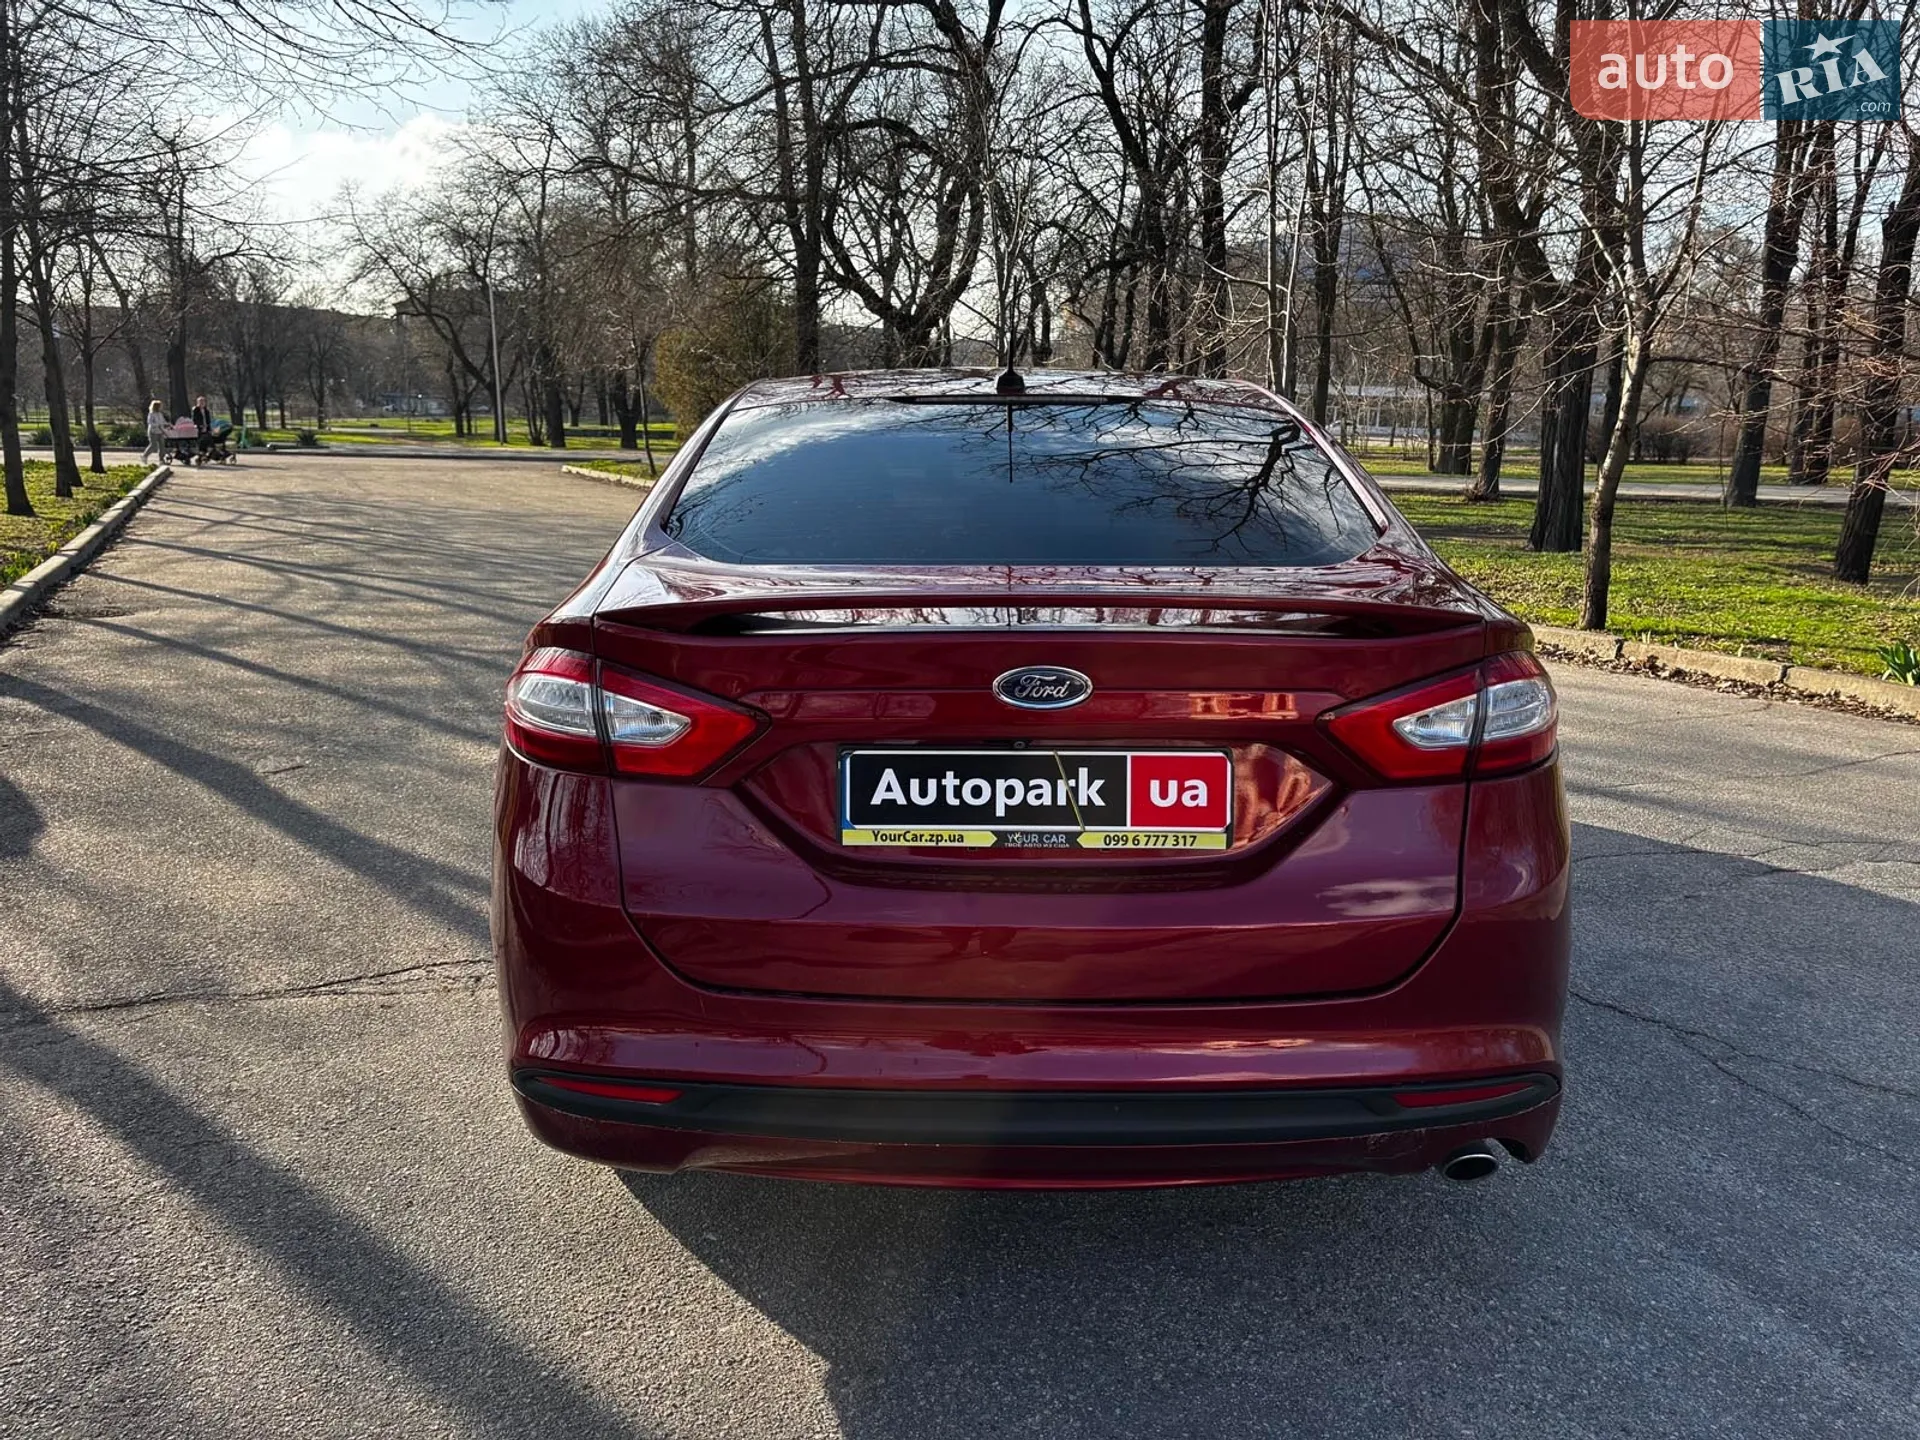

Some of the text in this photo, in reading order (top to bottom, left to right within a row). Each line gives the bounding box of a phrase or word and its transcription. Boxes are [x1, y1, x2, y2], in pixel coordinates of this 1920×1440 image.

[1014, 674, 1070, 698] Ford
[870, 767, 1208, 817] Autopark ua
[872, 830, 964, 845] YourCar.zp.ua
[1043, 833, 1066, 844] CAR
[1103, 834, 1197, 847] 099 6 777 317
